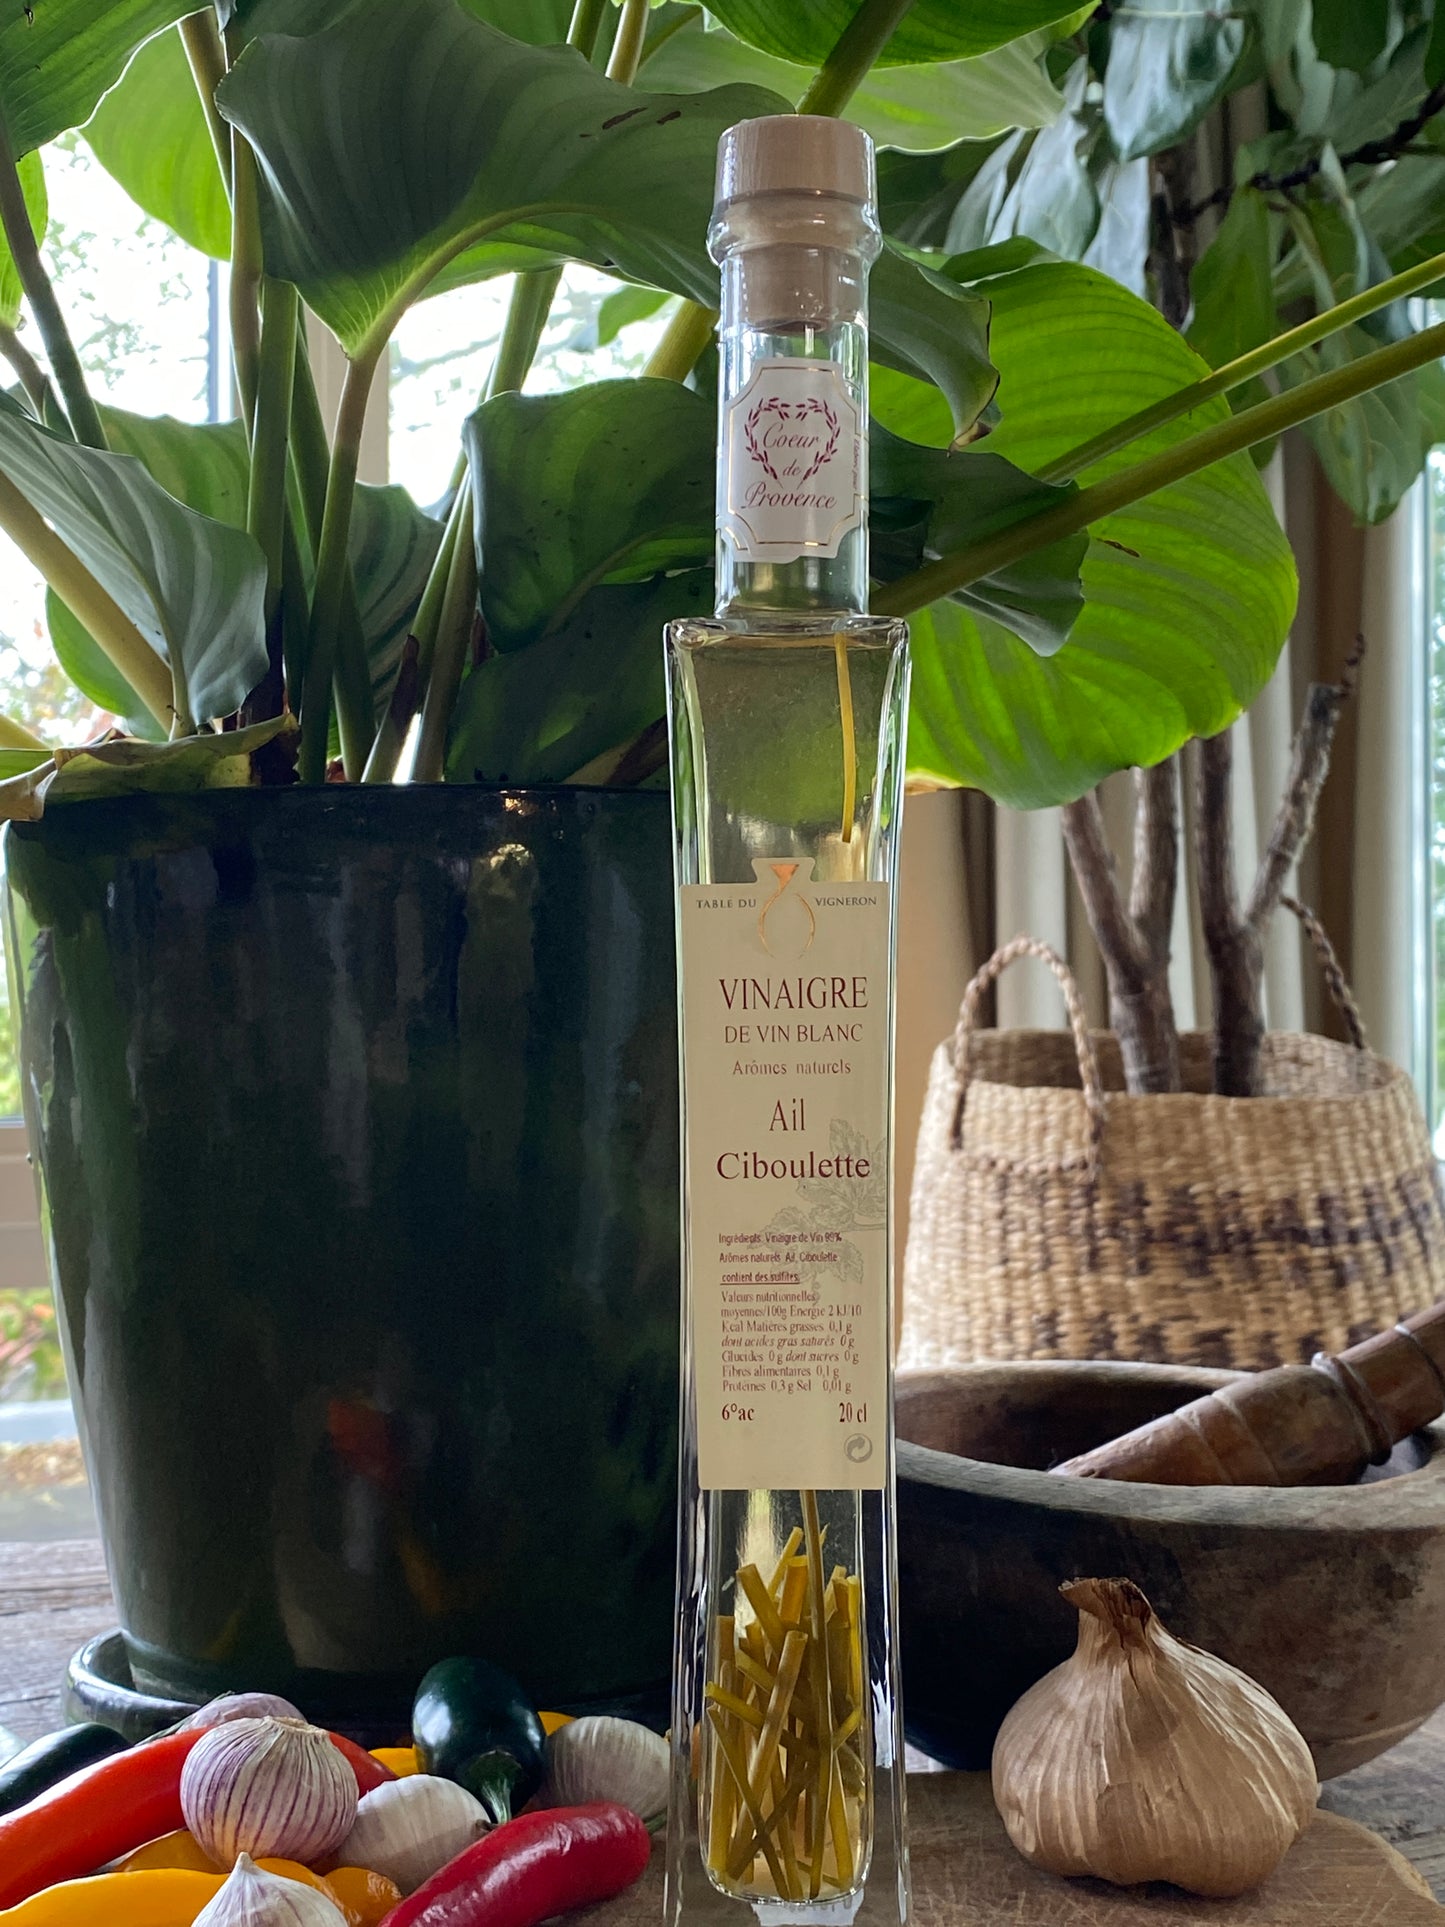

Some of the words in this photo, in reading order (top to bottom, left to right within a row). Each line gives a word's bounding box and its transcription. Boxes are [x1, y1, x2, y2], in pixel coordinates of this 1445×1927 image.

[763, 422, 820, 449] Coeur
[782, 459, 801, 476] de
[741, 481, 838, 509] Provence
[696, 899, 733, 909] TABLE
[738, 899, 757, 908] DU
[815, 896, 877, 906] VIGNERON
[719, 976, 868, 1010] VINAIGRE
[724, 1025, 751, 1043] DE
[756, 1025, 790, 1043] VIN
[797, 1024, 863, 1042] BLANC
[732, 1060, 787, 1075] Arômes
[796, 1059, 851, 1074] naturels
[769, 1098, 806, 1131] Ail
[717, 1151, 870, 1179] Ciboulette
[799, 1232, 808, 1242] de
[810, 1232, 823, 1242] Vin
[720, 1252, 749, 1262] Arômes
[750, 1252, 781, 1262] naturels
[800, 1252, 838, 1262] Ciboulette
[722, 1272, 752, 1282] contient
[755, 1272, 768, 1282] des
[721, 1291, 753, 1302] Valeurs
[756, 1291, 816, 1302] nutritionnelles
[829, 1304, 834, 1317] 2
[722, 1320, 743, 1332] Kcal
[790, 1323, 824, 1335] grasses
[829, 1320, 842, 1333] 0,1
[846, 1323, 852, 1335] g
[722, 1335, 743, 1347] dont
[745, 1335, 774, 1347] acides
[777, 1337, 798, 1350] gras
[840, 1335, 847, 1347] 0
[848, 1338, 855, 1349] g
[722, 1350, 764, 1362] Glucides
[769, 1350, 775, 1361] 0
[777, 1353, 783, 1365] g
[786, 1350, 807, 1361] dont
[808, 1352, 839, 1361] sucres
[844, 1350, 850, 1361] 0
[853, 1353, 859, 1365] g
[722, 1365, 751, 1377] Fibres
[754, 1365, 812, 1377] alimentaires
[833, 1368, 839, 1379] g
[788, 1383, 794, 1395] g
[797, 1379, 811, 1391] Sel
[823, 1379, 842, 1393] 0,01
[845, 1383, 852, 1395] g
[839, 1402, 853, 1422] 20
[856, 1402, 867, 1422] cl
